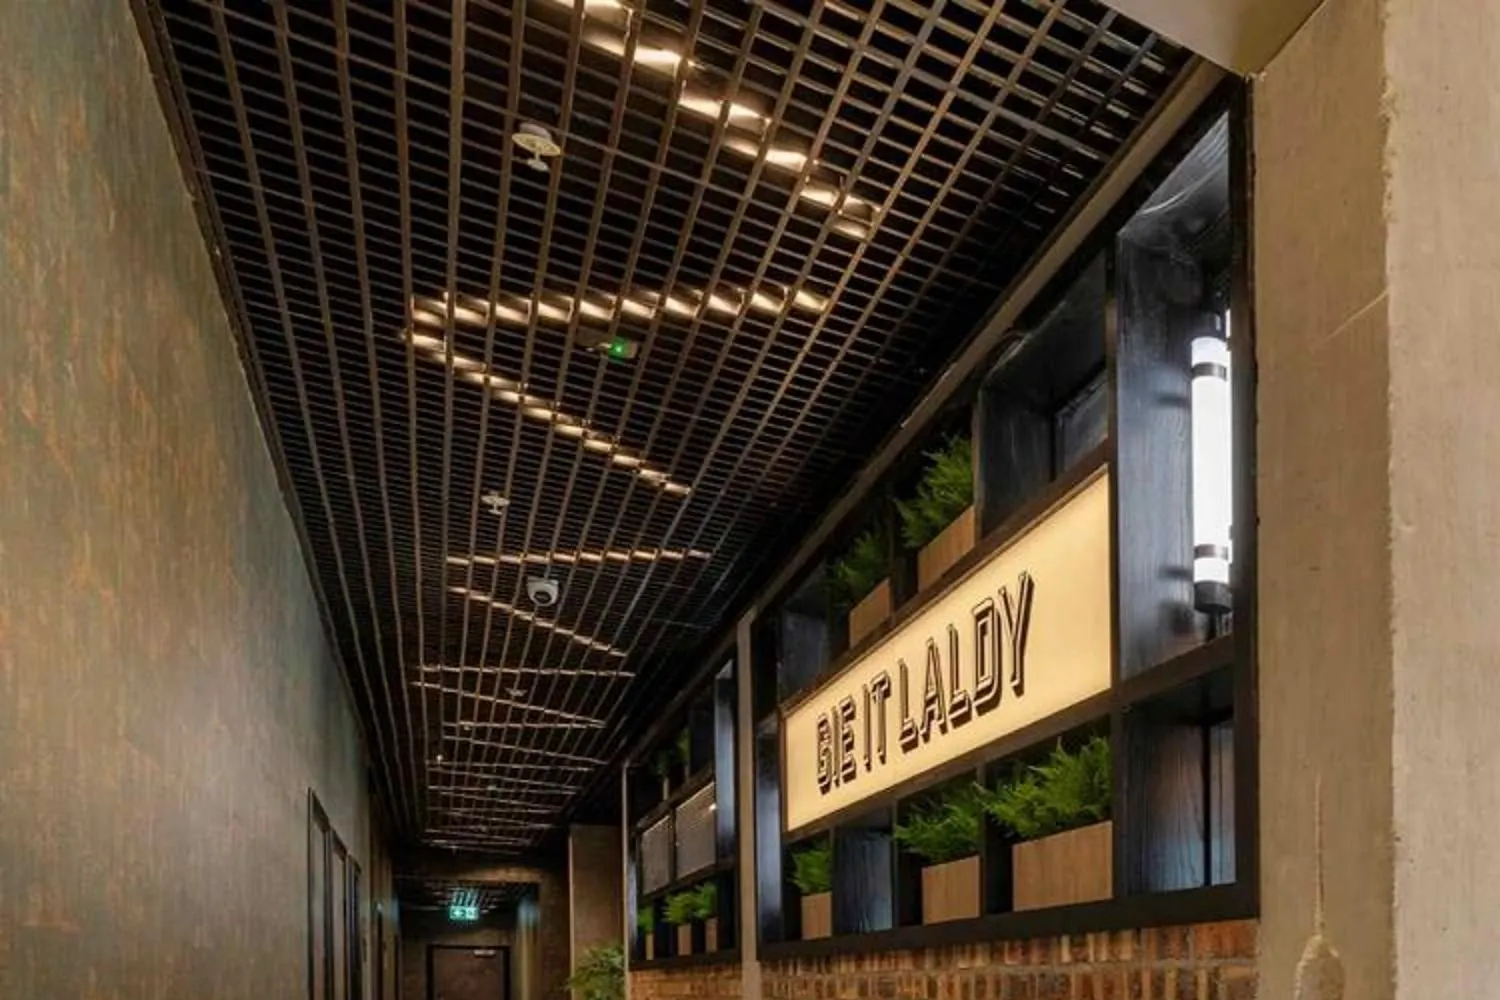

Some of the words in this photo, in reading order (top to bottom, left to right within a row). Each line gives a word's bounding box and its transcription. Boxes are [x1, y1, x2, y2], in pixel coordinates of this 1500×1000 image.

[817, 694, 857, 796] GIE
[862, 670, 892, 772] IT
[898, 570, 1035, 753] LALDY
